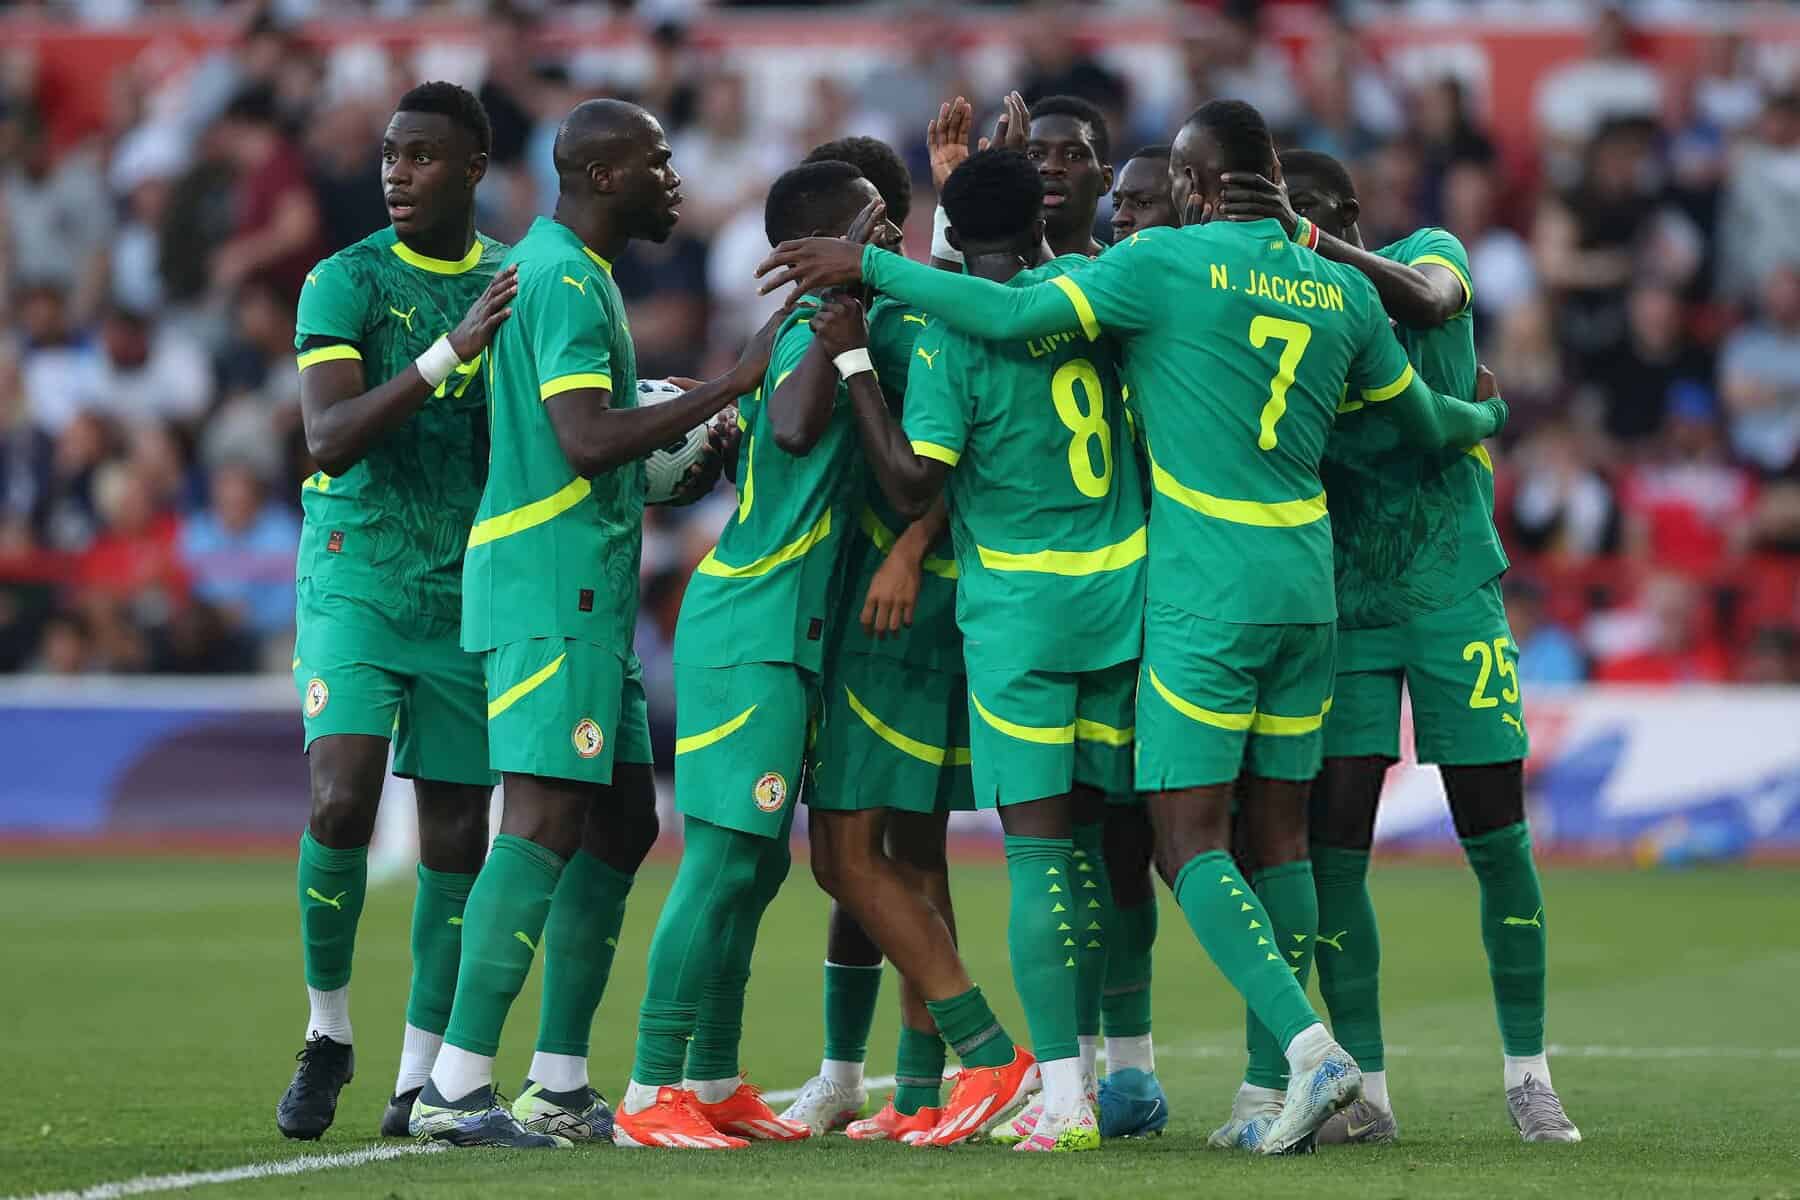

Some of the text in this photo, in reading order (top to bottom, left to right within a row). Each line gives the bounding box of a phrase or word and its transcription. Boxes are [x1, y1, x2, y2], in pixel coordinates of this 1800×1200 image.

[1210, 263, 1345, 313] N. JACKSON
[1051, 358, 1112, 498] 8
[1249, 315, 1312, 451] 7
[1463, 638, 1519, 708] 25
